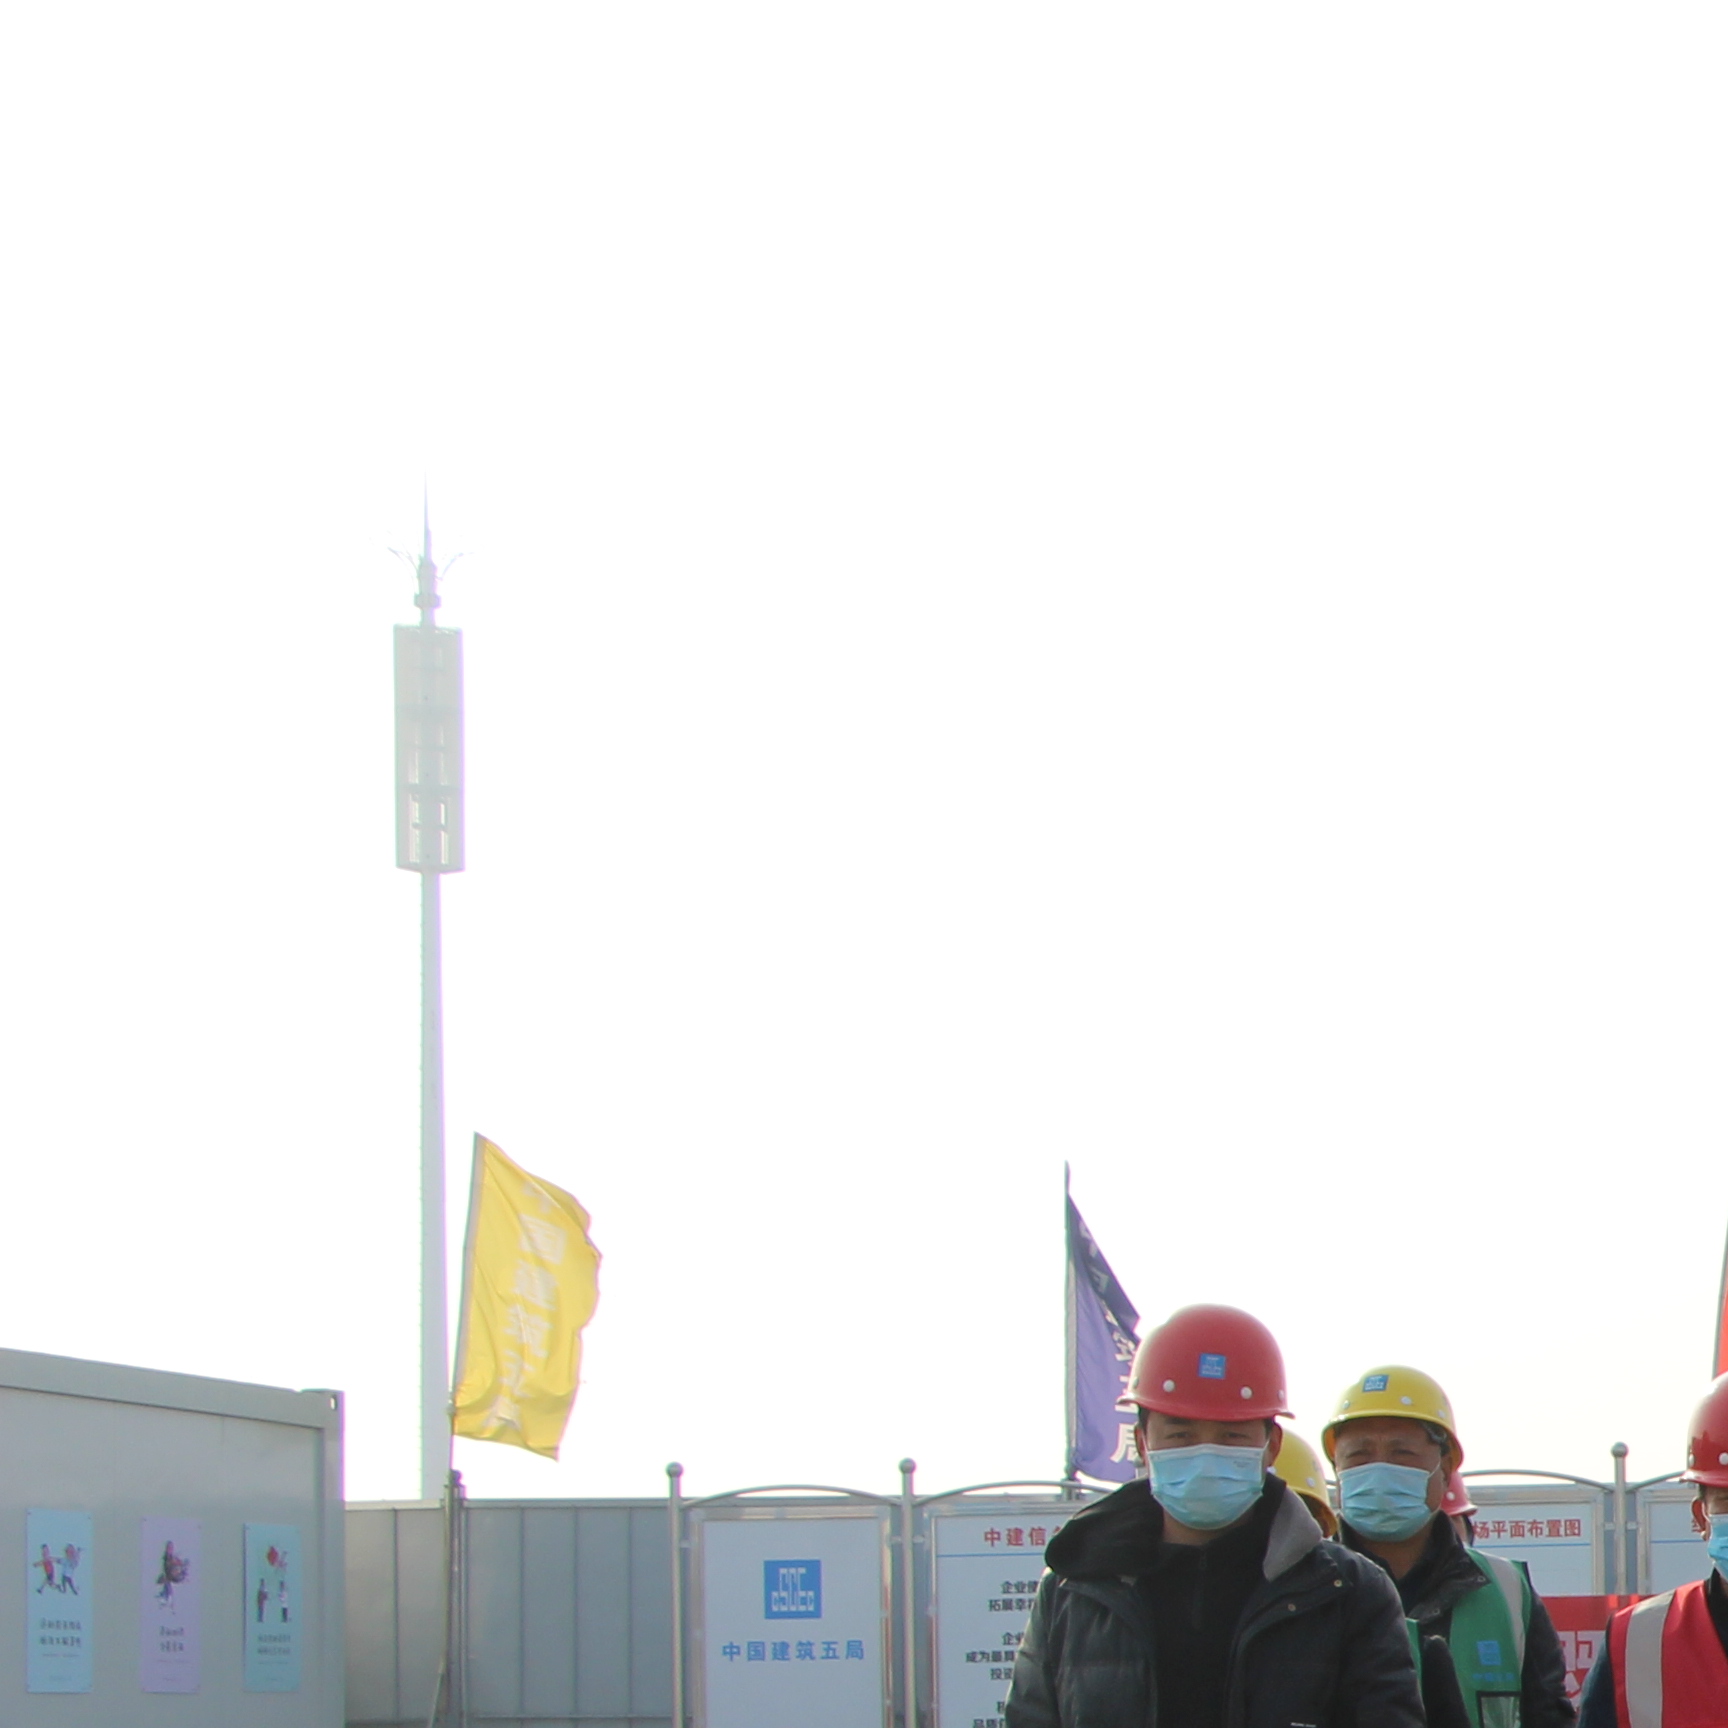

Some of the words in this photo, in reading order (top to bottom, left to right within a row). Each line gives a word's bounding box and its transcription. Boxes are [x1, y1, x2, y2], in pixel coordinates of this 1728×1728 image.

[722, 1640, 865, 1662] 中国建筑五局
